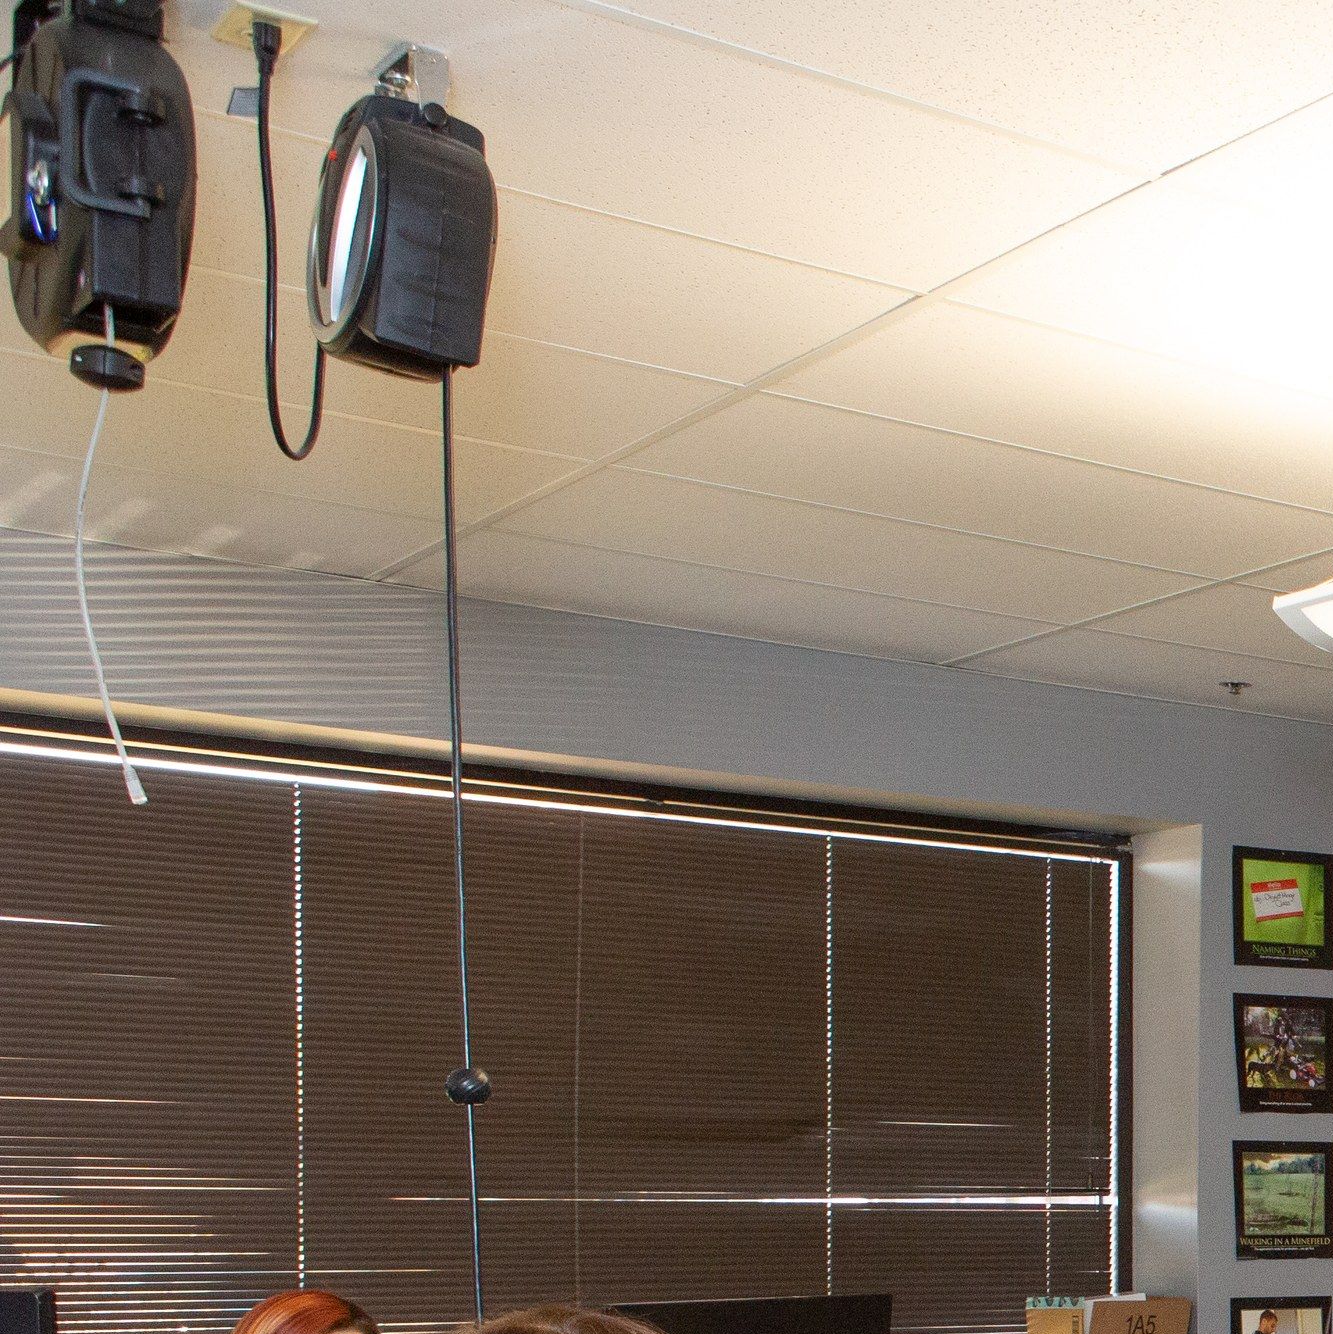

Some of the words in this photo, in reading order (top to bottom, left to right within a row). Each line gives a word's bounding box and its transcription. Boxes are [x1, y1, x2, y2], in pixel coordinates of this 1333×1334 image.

[1252, 944, 1286, 956] NAMING
[1240, 1237, 1273, 1246] WALKING
[1291, 1237, 1331, 1246] MINEFIELD
[1126, 1315, 1157, 1334] 1A5
